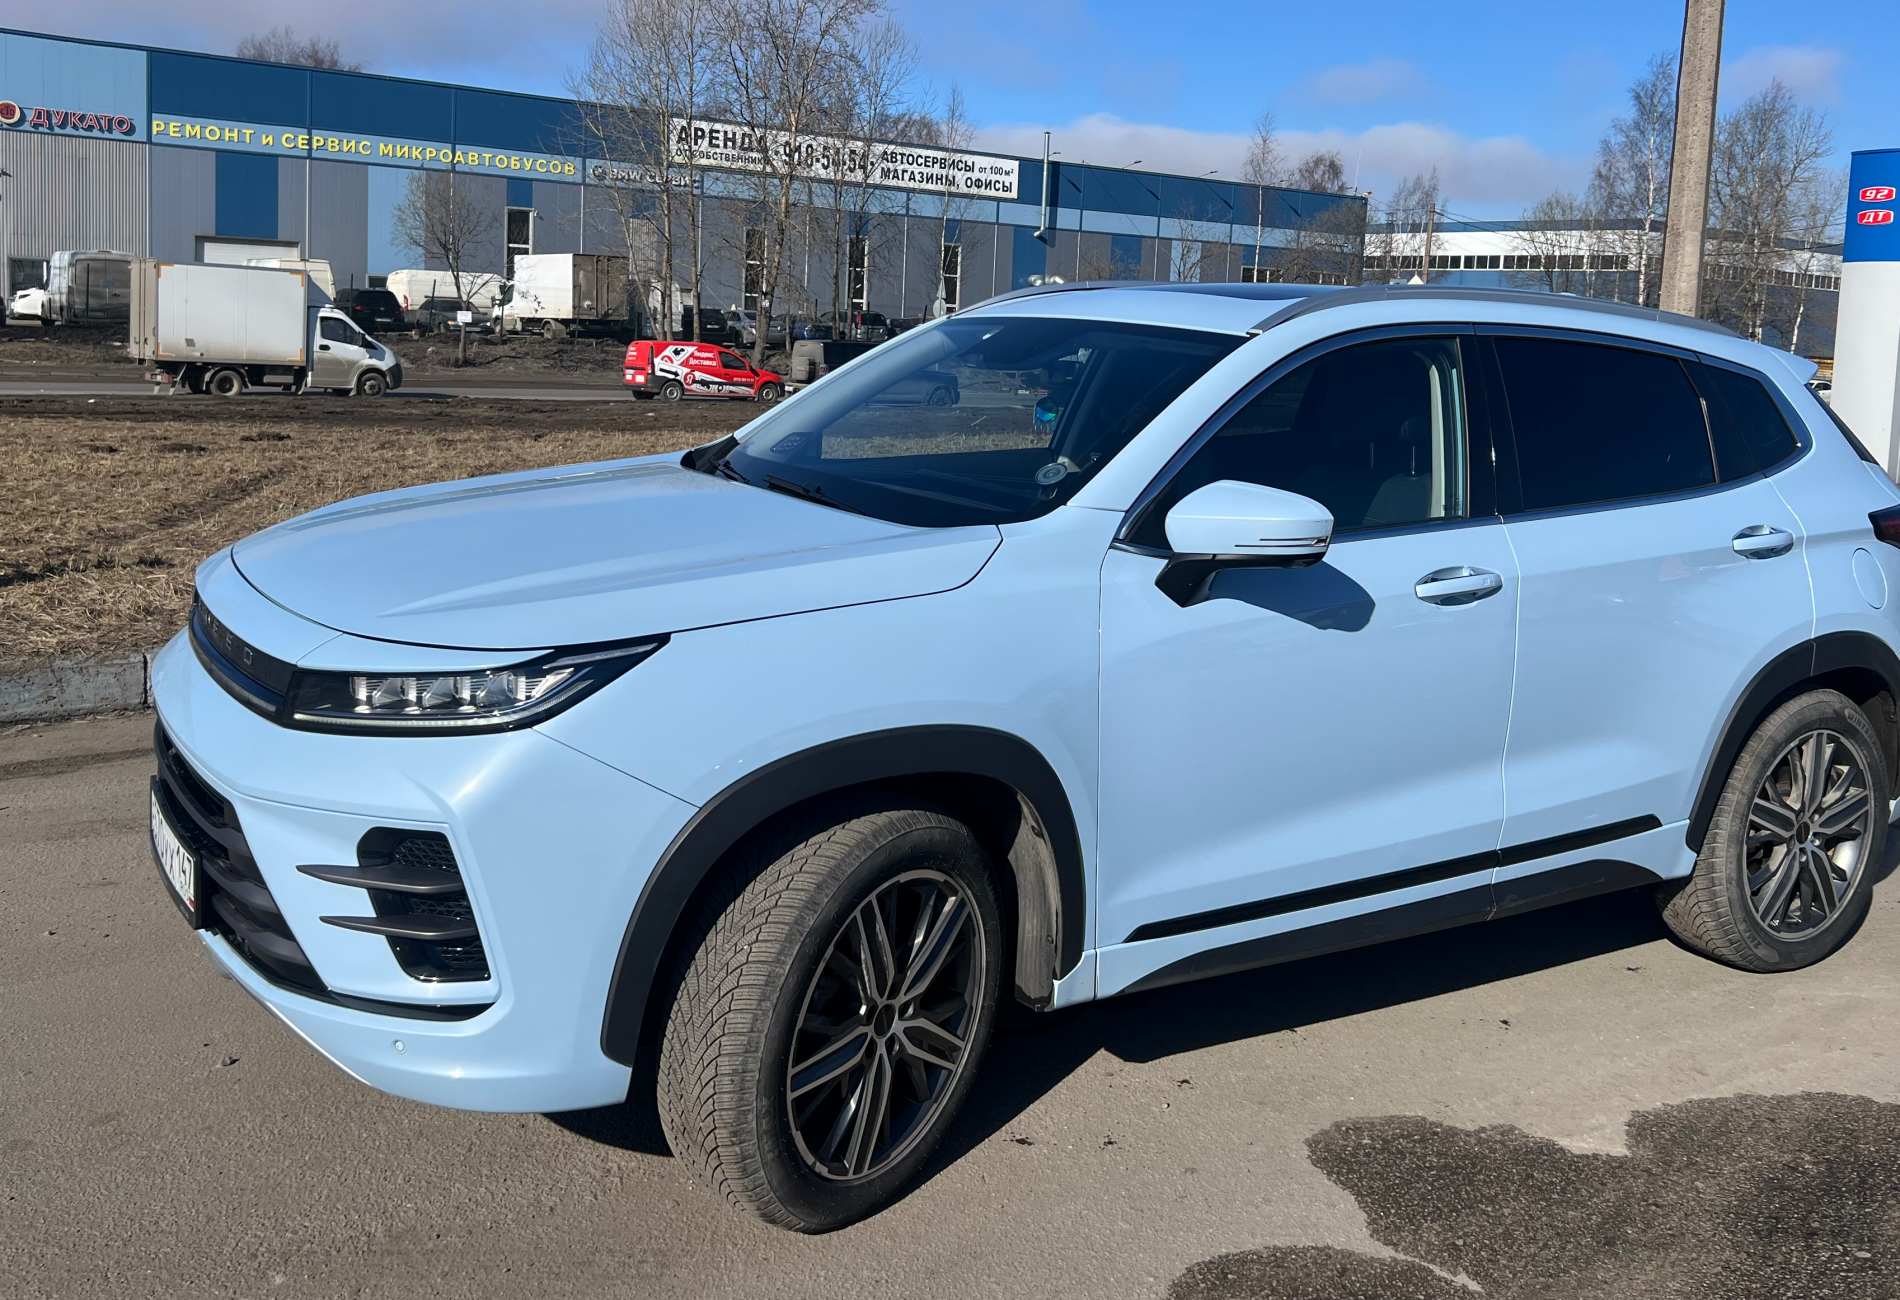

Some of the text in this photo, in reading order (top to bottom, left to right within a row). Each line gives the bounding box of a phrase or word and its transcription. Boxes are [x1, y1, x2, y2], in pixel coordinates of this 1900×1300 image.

[29, 107, 131, 132] ДУКАТО
[152, 120, 255, 144] РЕМОНТ
[281, 133, 373, 155] СЕРВИС
[379, 142, 575, 176] МИКРОАВТОБУСОВ
[882, 150, 975, 173] АВТОСЕРВИСЫ
[880, 167, 1013, 193] МАГАЗИНЫ, ОФИСЫ
[1865, 189, 1889, 199] 92
[1862, 211, 1887, 223] ДТ
[689, 357, 717, 366] Доставка
[694, 350, 715, 358] Яндекс
[176, 844, 193, 890] 147
